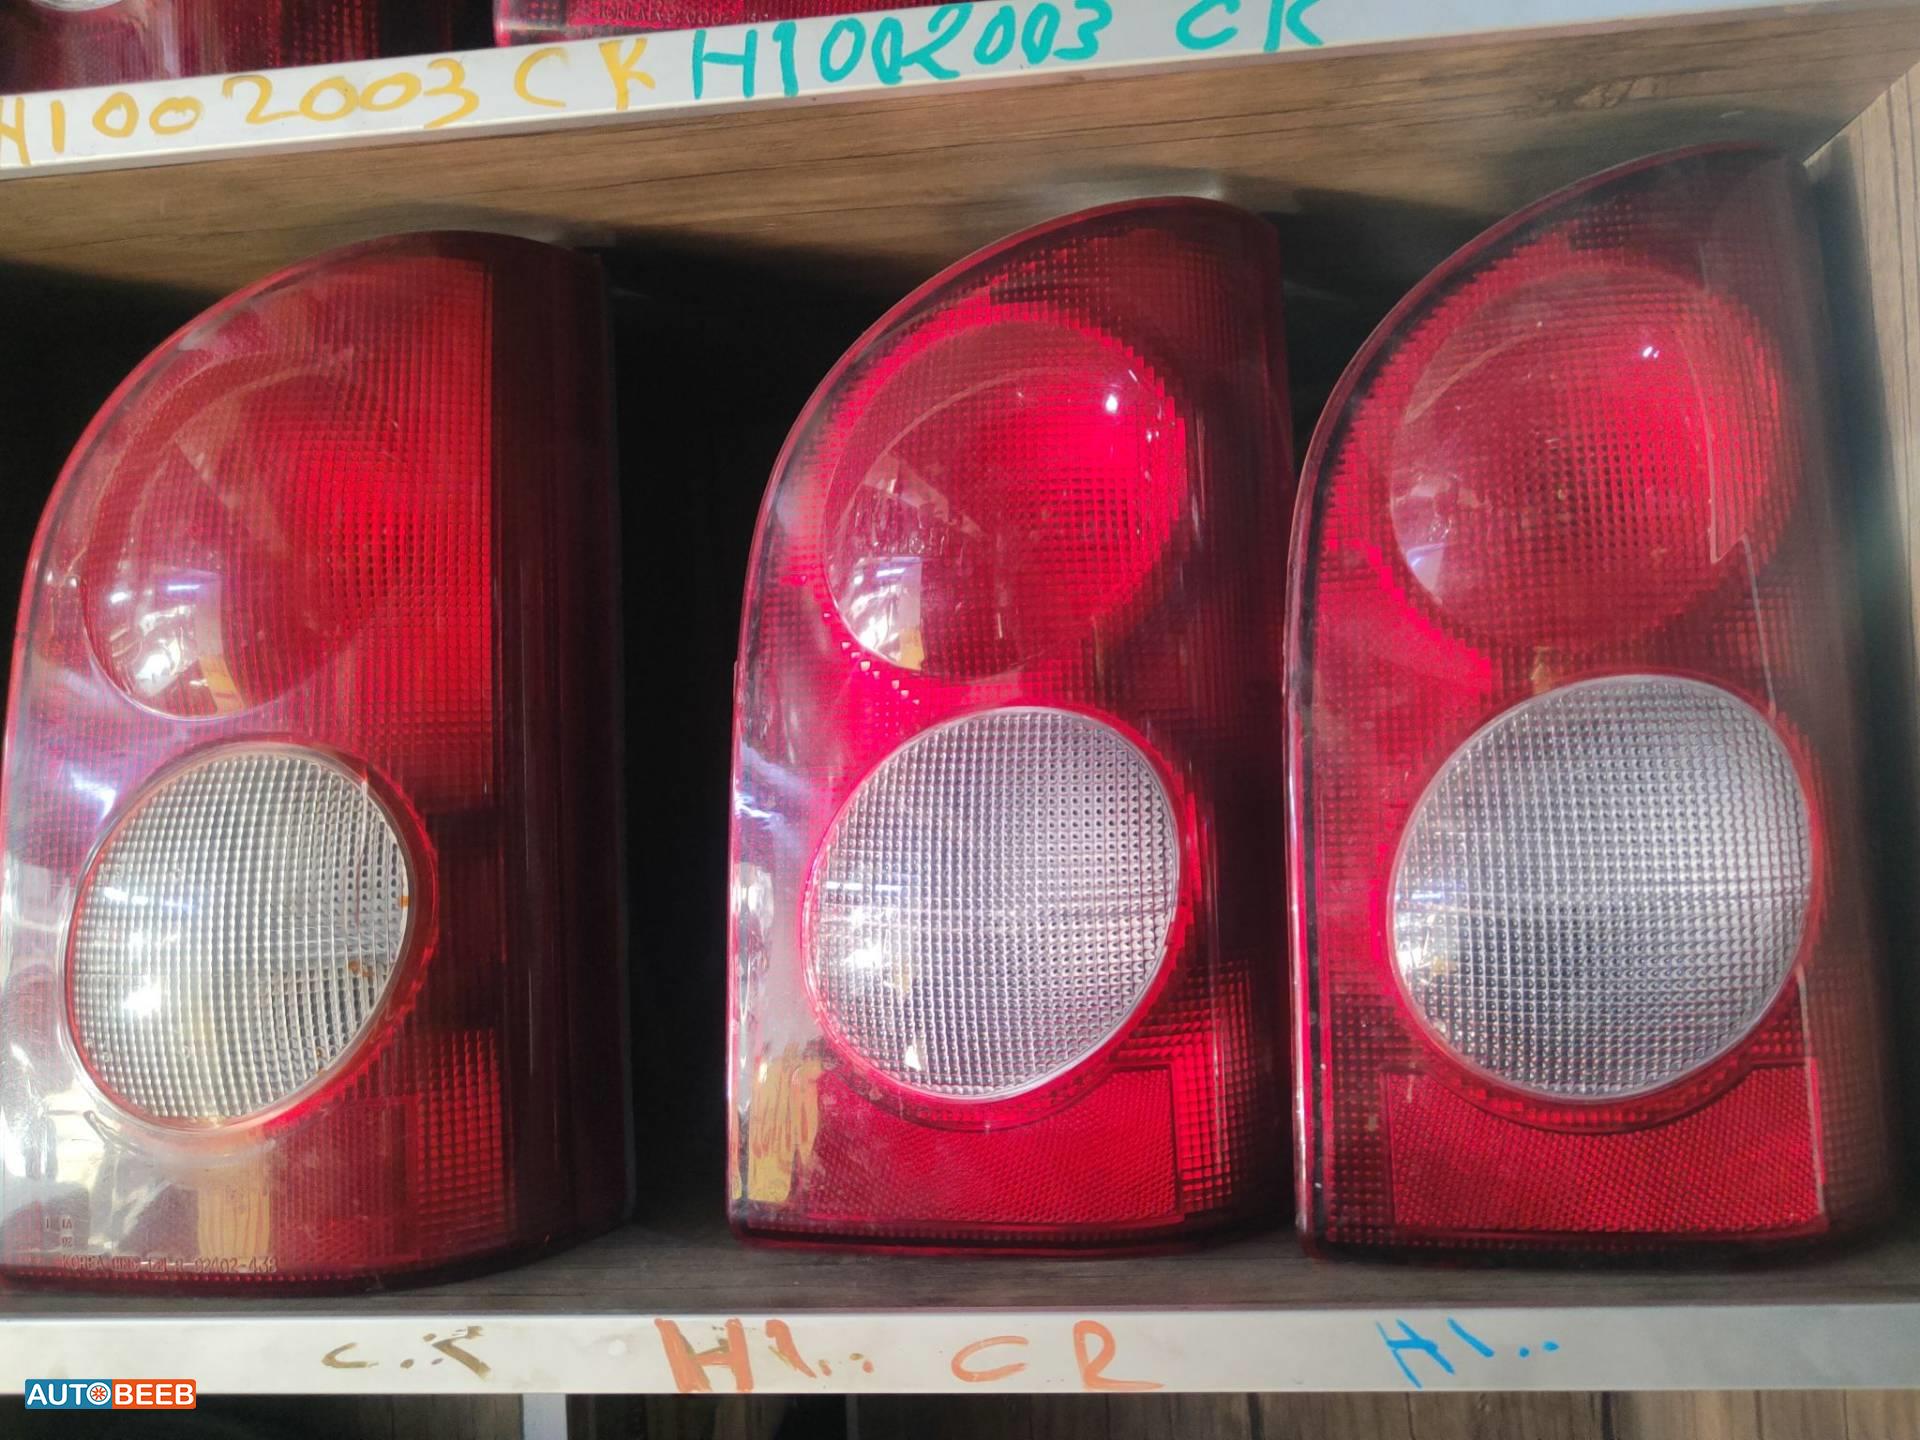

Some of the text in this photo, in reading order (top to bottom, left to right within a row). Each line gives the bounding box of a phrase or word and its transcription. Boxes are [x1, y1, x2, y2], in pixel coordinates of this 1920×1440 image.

[1176, 0, 1241, 50] C
[514, 46, 567, 108] C
[951, 1335, 1029, 1383] C
